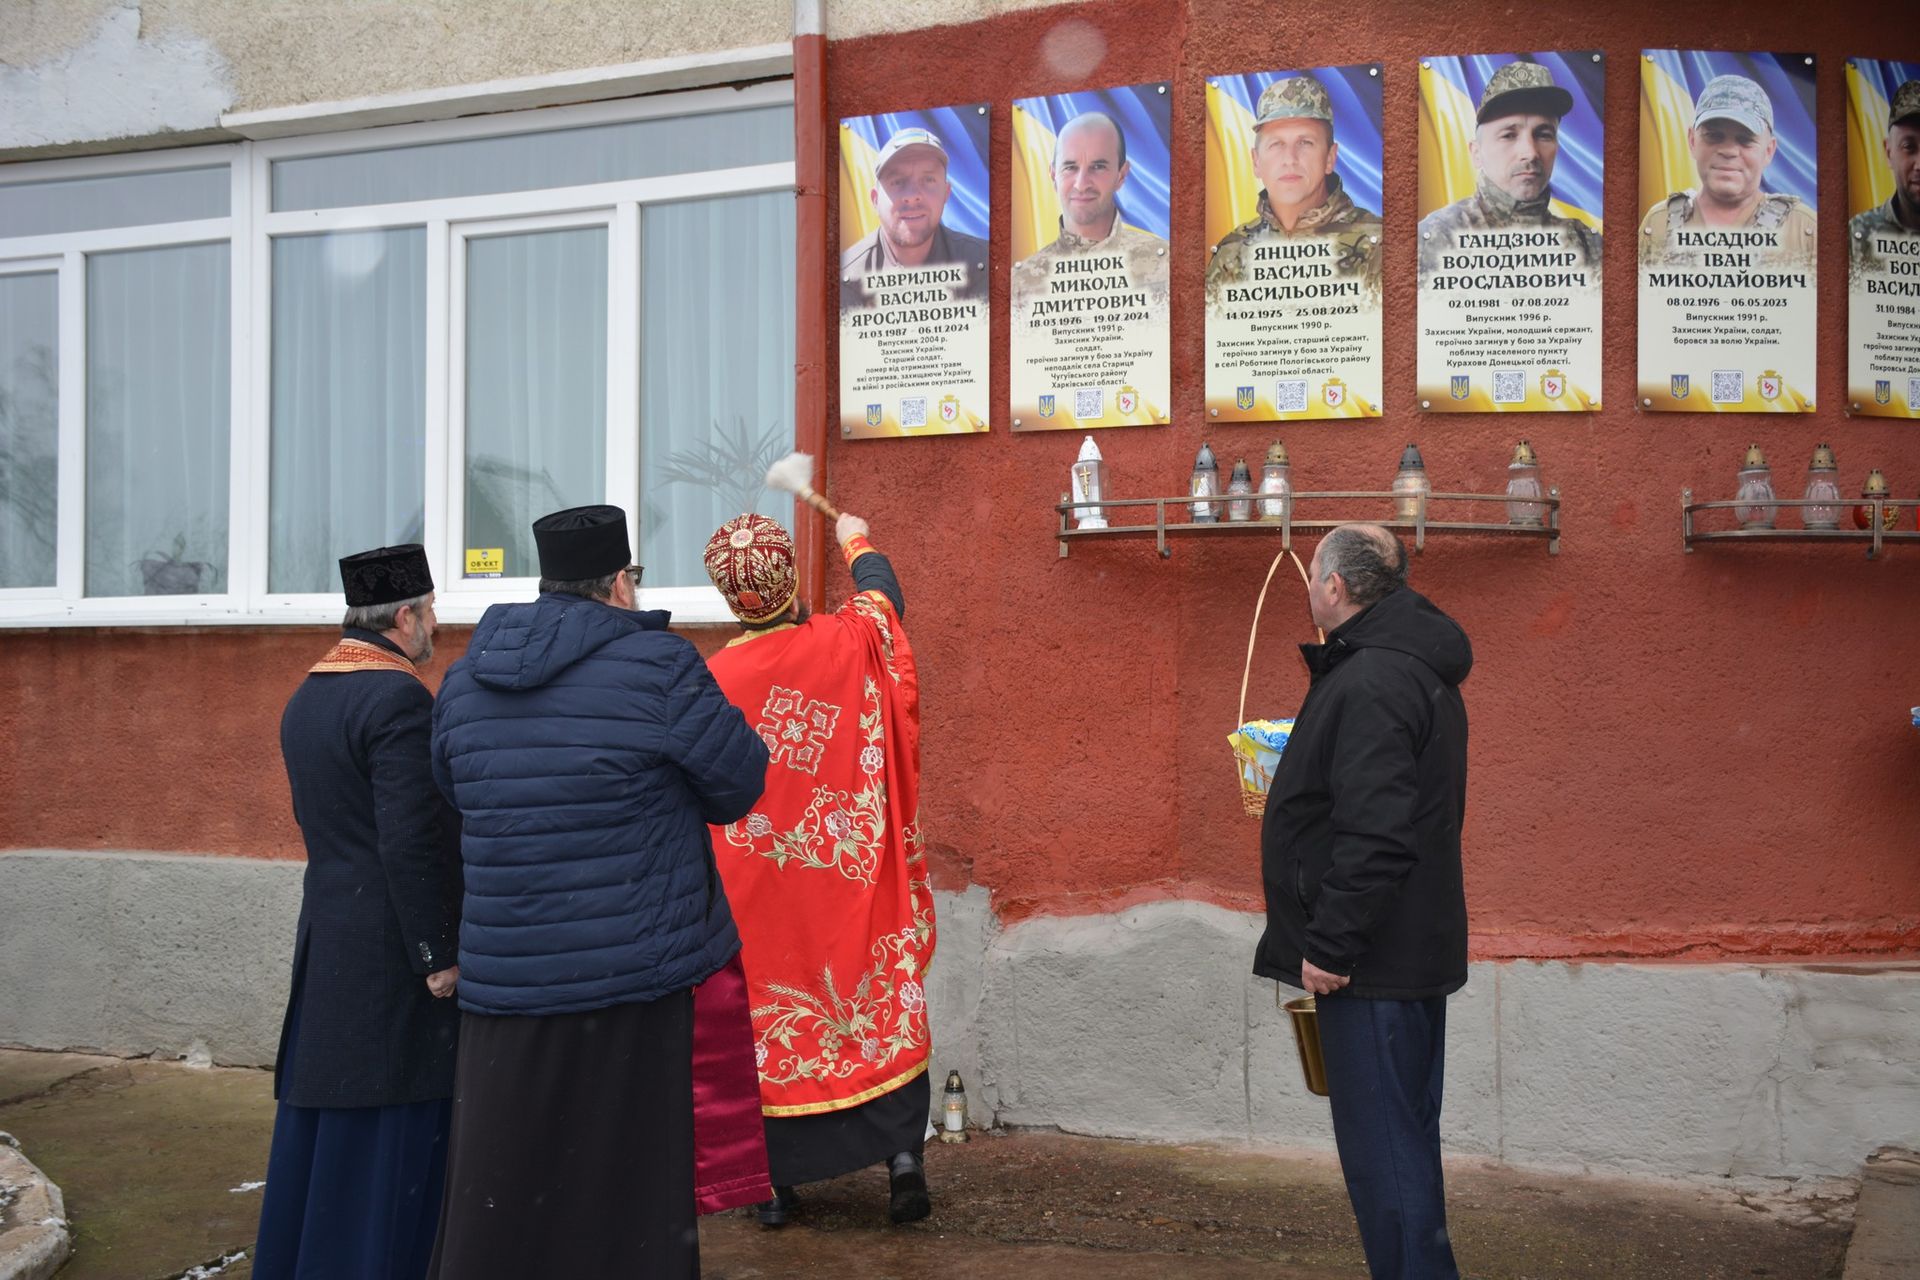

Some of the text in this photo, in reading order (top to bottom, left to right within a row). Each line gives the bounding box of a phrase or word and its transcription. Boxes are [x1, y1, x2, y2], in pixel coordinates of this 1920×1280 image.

[1459, 232, 1560, 250] ГАНДЗЮК
[1678, 232, 1778, 249] НАСАДЮК
[1254, 243, 1331, 261] ЯНЦЮК
[1442, 252, 1577, 270] ВОЛОДИМИР
[1704, 254, 1751, 267] ІВАН
[1055, 256, 1124, 274] ЯНЦЮК
[1254, 264, 1332, 281] ВАСИЛЬ
[867, 269, 962, 288] ГАВРИЛЮК
[1051, 276, 1128, 294] МИКОЛА
[1432, 273, 1587, 290] ЯРОСЛАВОВИЧ
[1649, 270, 1807, 289] МИКОЛАЙОВИЧ
[881, 289, 948, 306] ВАСИЛЬ
[1226, 282, 1360, 302] ВАСИЛЬОВИЧ
[1032, 294, 1146, 317] ДМИТРОВИЧ
[852, 306, 977, 327] ЯРОСЛАВОВИЧ
